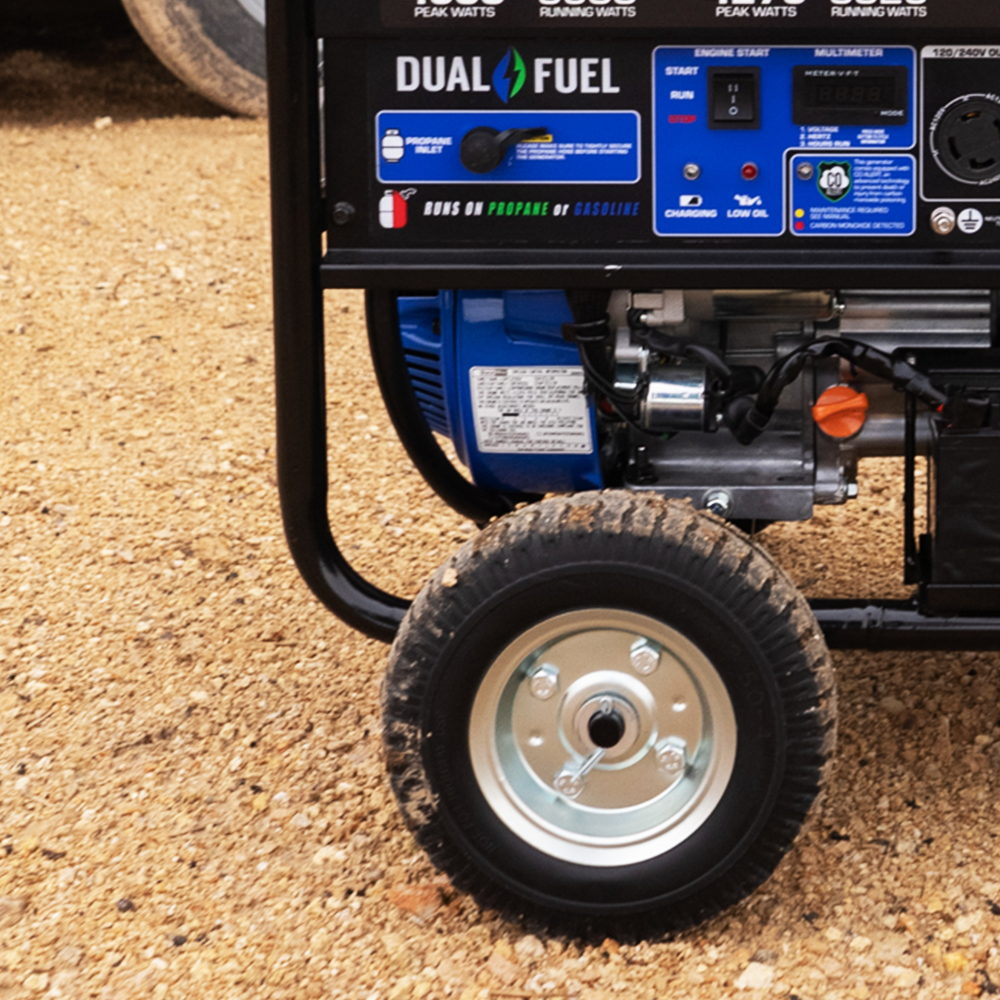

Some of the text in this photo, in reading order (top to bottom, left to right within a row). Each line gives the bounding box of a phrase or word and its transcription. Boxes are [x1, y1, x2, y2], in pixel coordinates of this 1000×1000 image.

[414, 6, 496, 18] PEAK WATTS
[539, 6, 637, 18] RUNNING WATTS
[716, 6, 797, 18] PEAK WATTS
[830, 6, 927, 17] RUNNING WATTS
[694, 48, 771, 58] ENGINE START
[814, 47, 884, 58] MULTIMETER
[932, 47, 986, 58] 120/240V
[396, 55, 621, 94] DUAL FUEL
[664, 66, 700, 77] START
[670, 89, 695, 100] RUN
[405, 136, 453, 146] PROPANE
[423, 201, 640, 216] RUNS ON PROPANE or GASOLINE
[664, 208, 718, 218] CHARGING
[726, 208, 769, 218] LOW OIL
